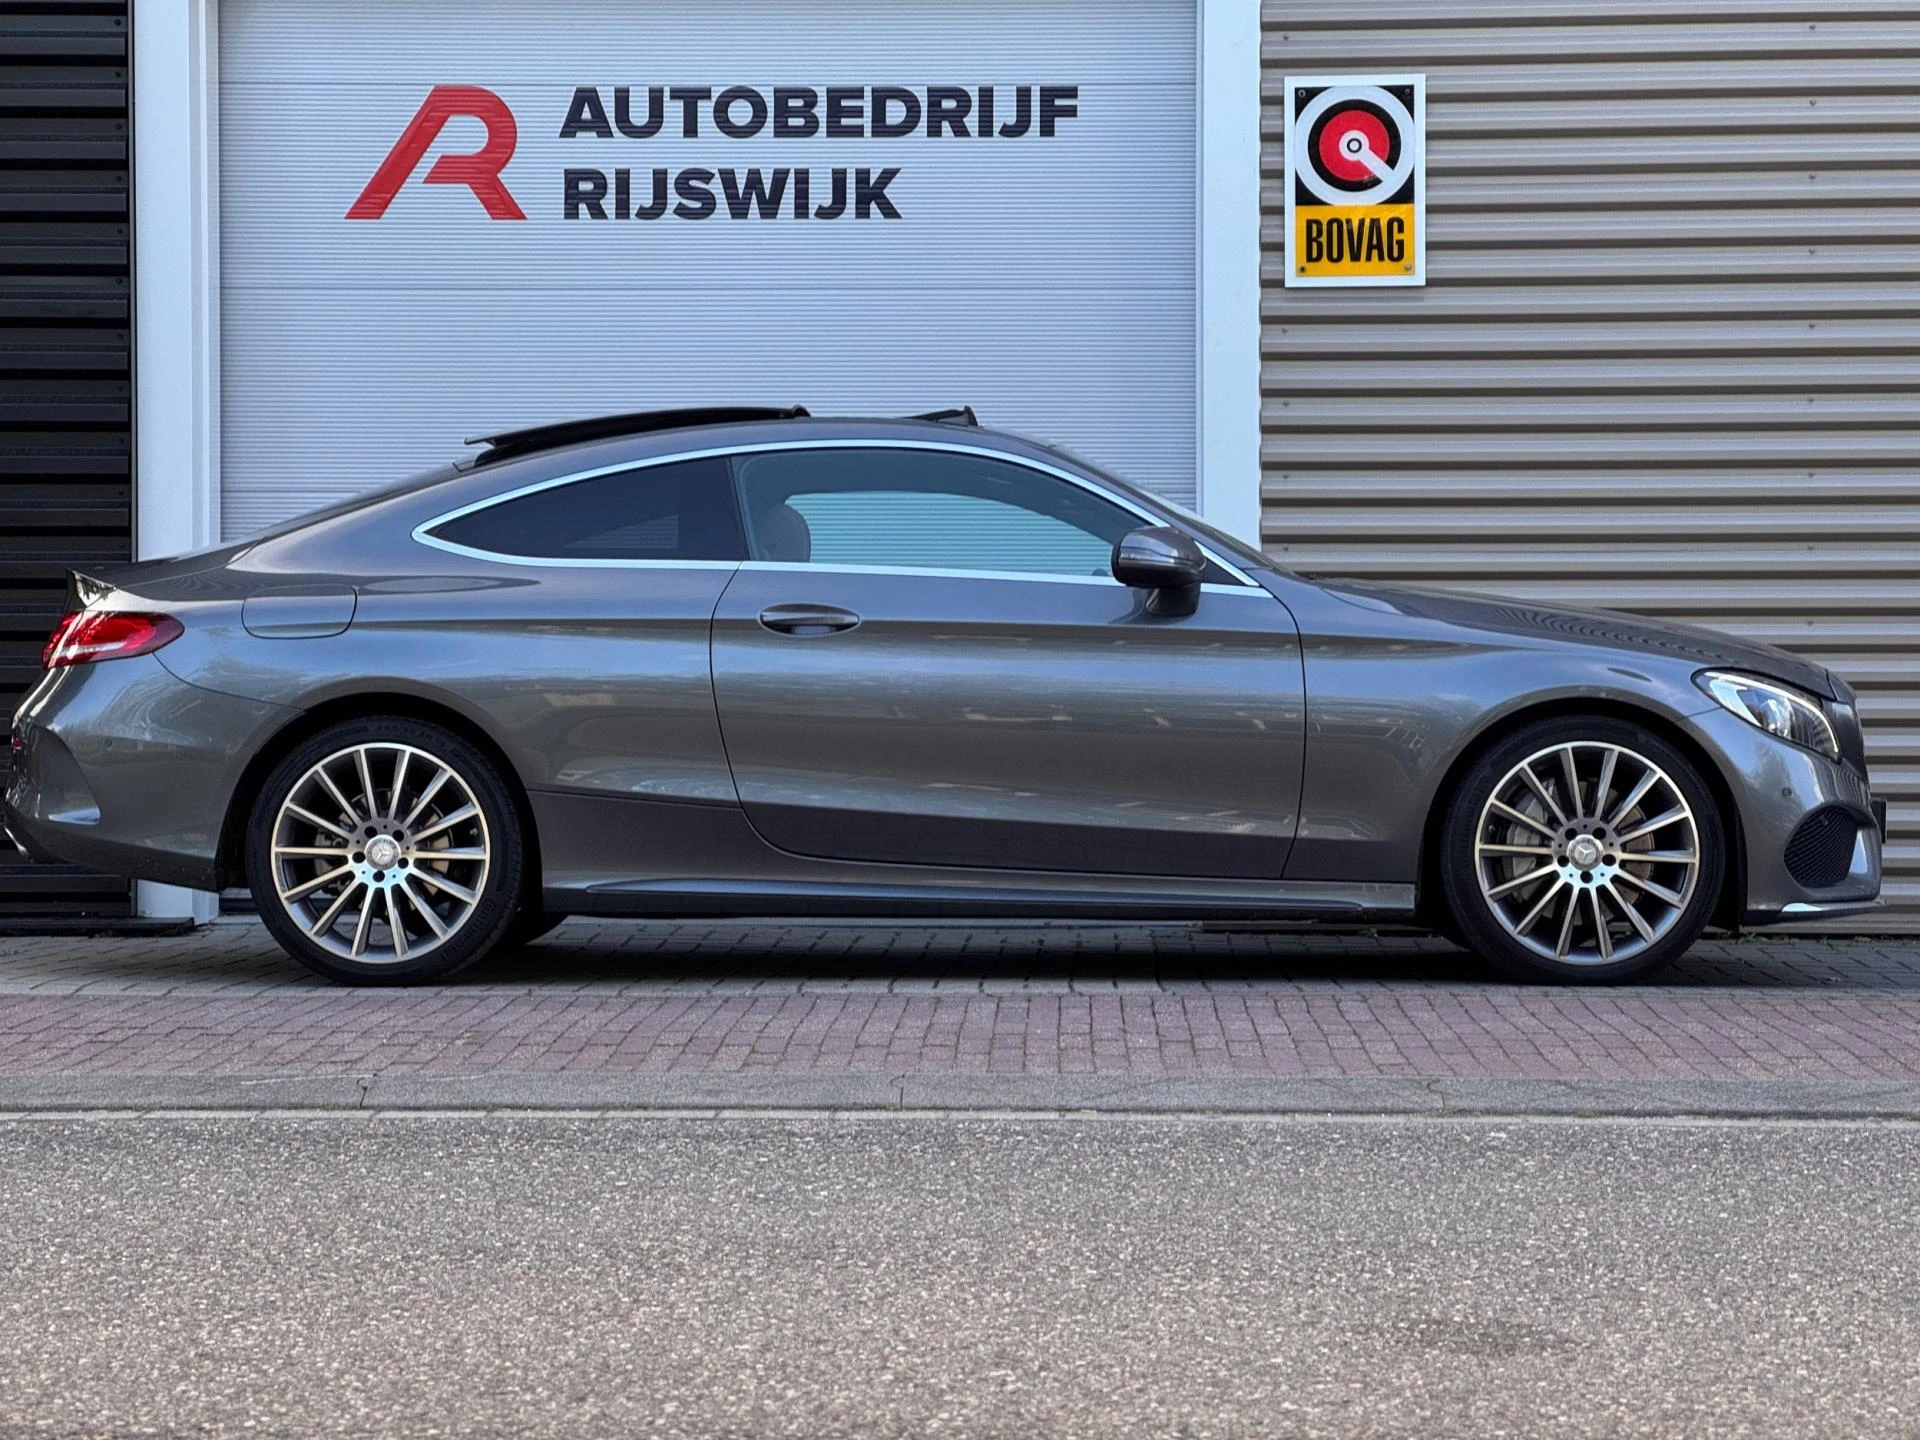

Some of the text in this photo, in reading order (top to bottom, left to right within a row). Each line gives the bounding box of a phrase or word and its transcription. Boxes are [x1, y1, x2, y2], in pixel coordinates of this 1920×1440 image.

[560, 86, 1078, 138] AUTOBEDRIJF
[564, 168, 901, 220] RIJSWIJK
[1306, 217, 1404, 263] BOVAG
